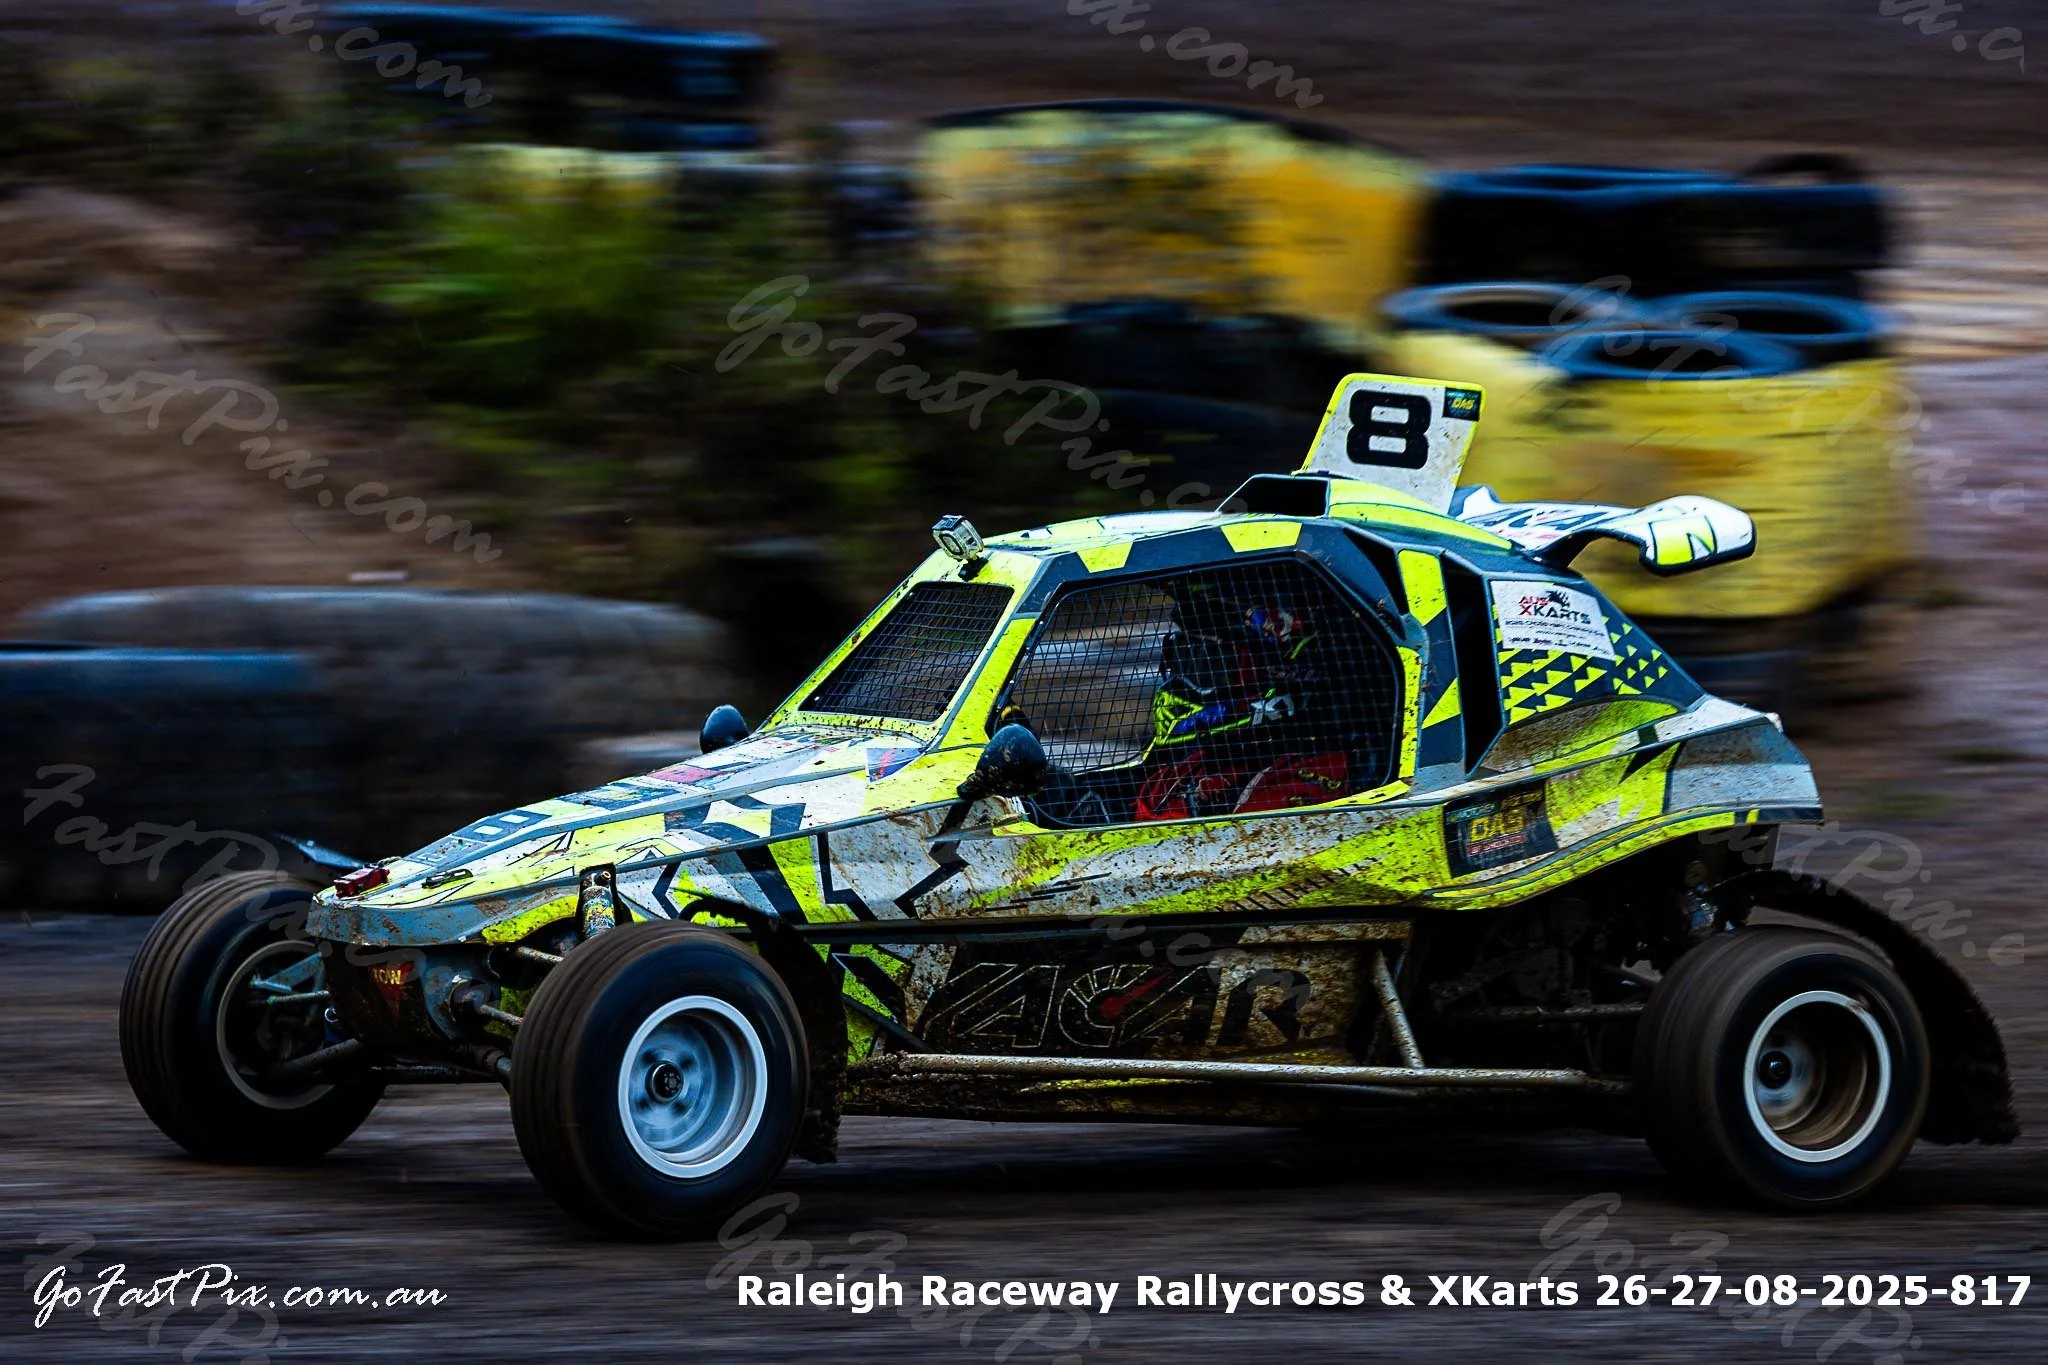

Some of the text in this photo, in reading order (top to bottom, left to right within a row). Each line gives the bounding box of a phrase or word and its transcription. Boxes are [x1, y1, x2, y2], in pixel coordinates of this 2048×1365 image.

[1346, 389, 1431, 470] 8
[1518, 595, 1549, 607] AUS
[1518, 604, 1591, 625] XKARTS
